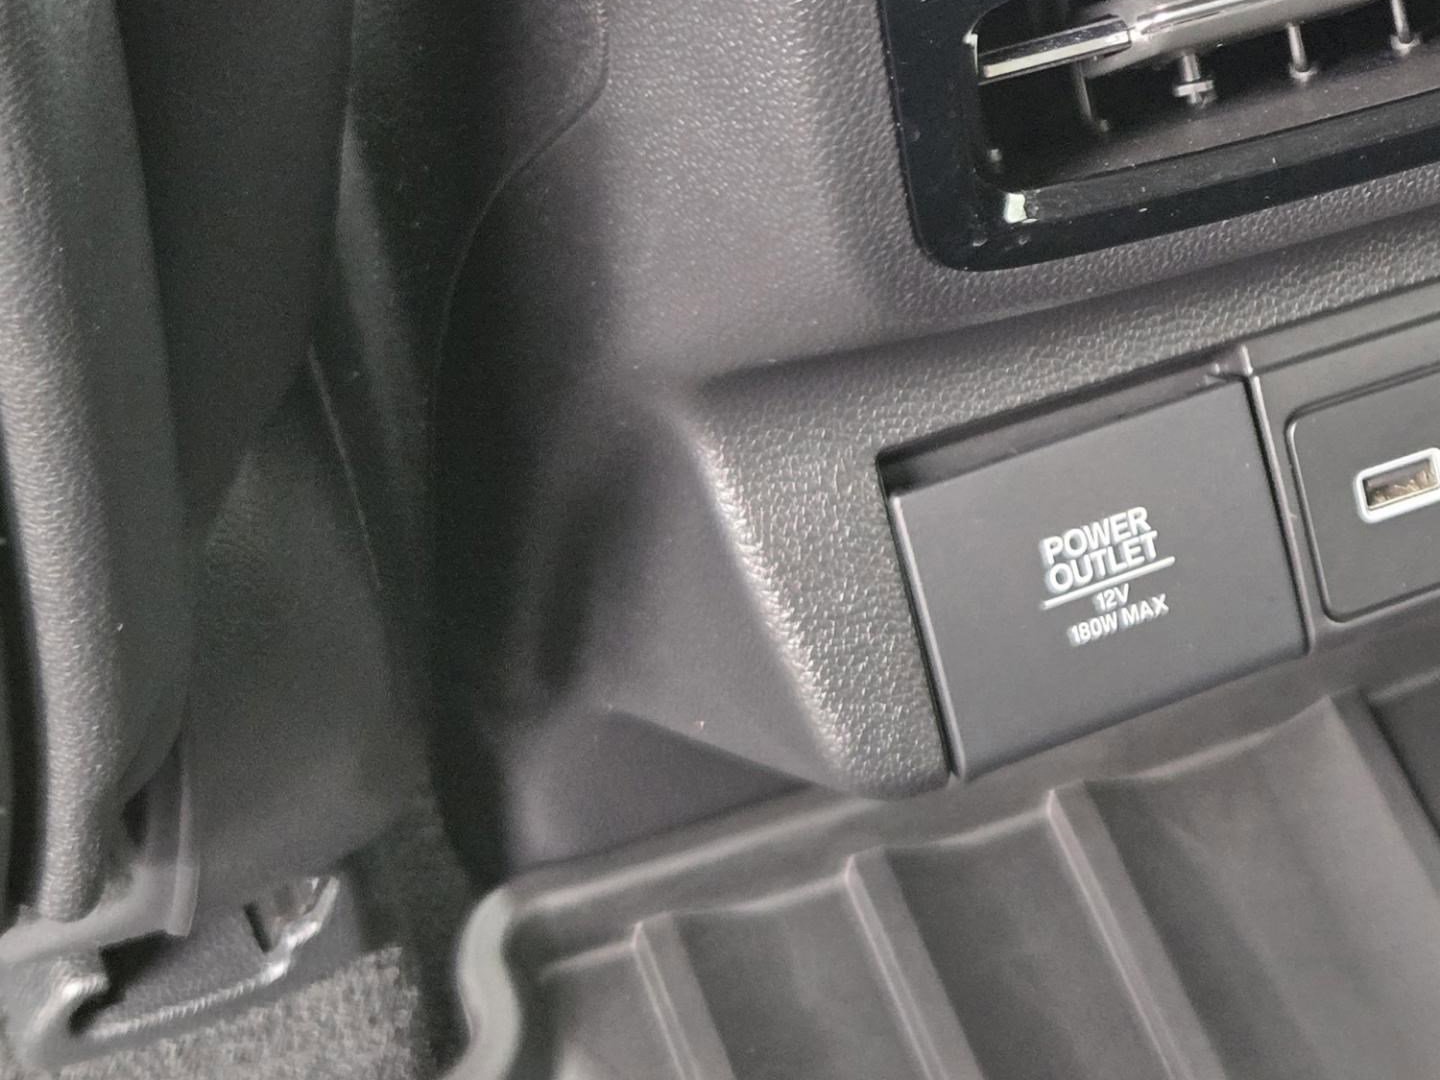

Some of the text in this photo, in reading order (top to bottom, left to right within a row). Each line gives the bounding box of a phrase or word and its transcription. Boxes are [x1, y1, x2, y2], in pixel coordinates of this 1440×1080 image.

[1039, 506, 1152, 567] POWER
[1044, 530, 1158, 595] OUTLET
[1066, 593, 1169, 647] 180W MAX
[1093, 583, 1130, 613] 12V
